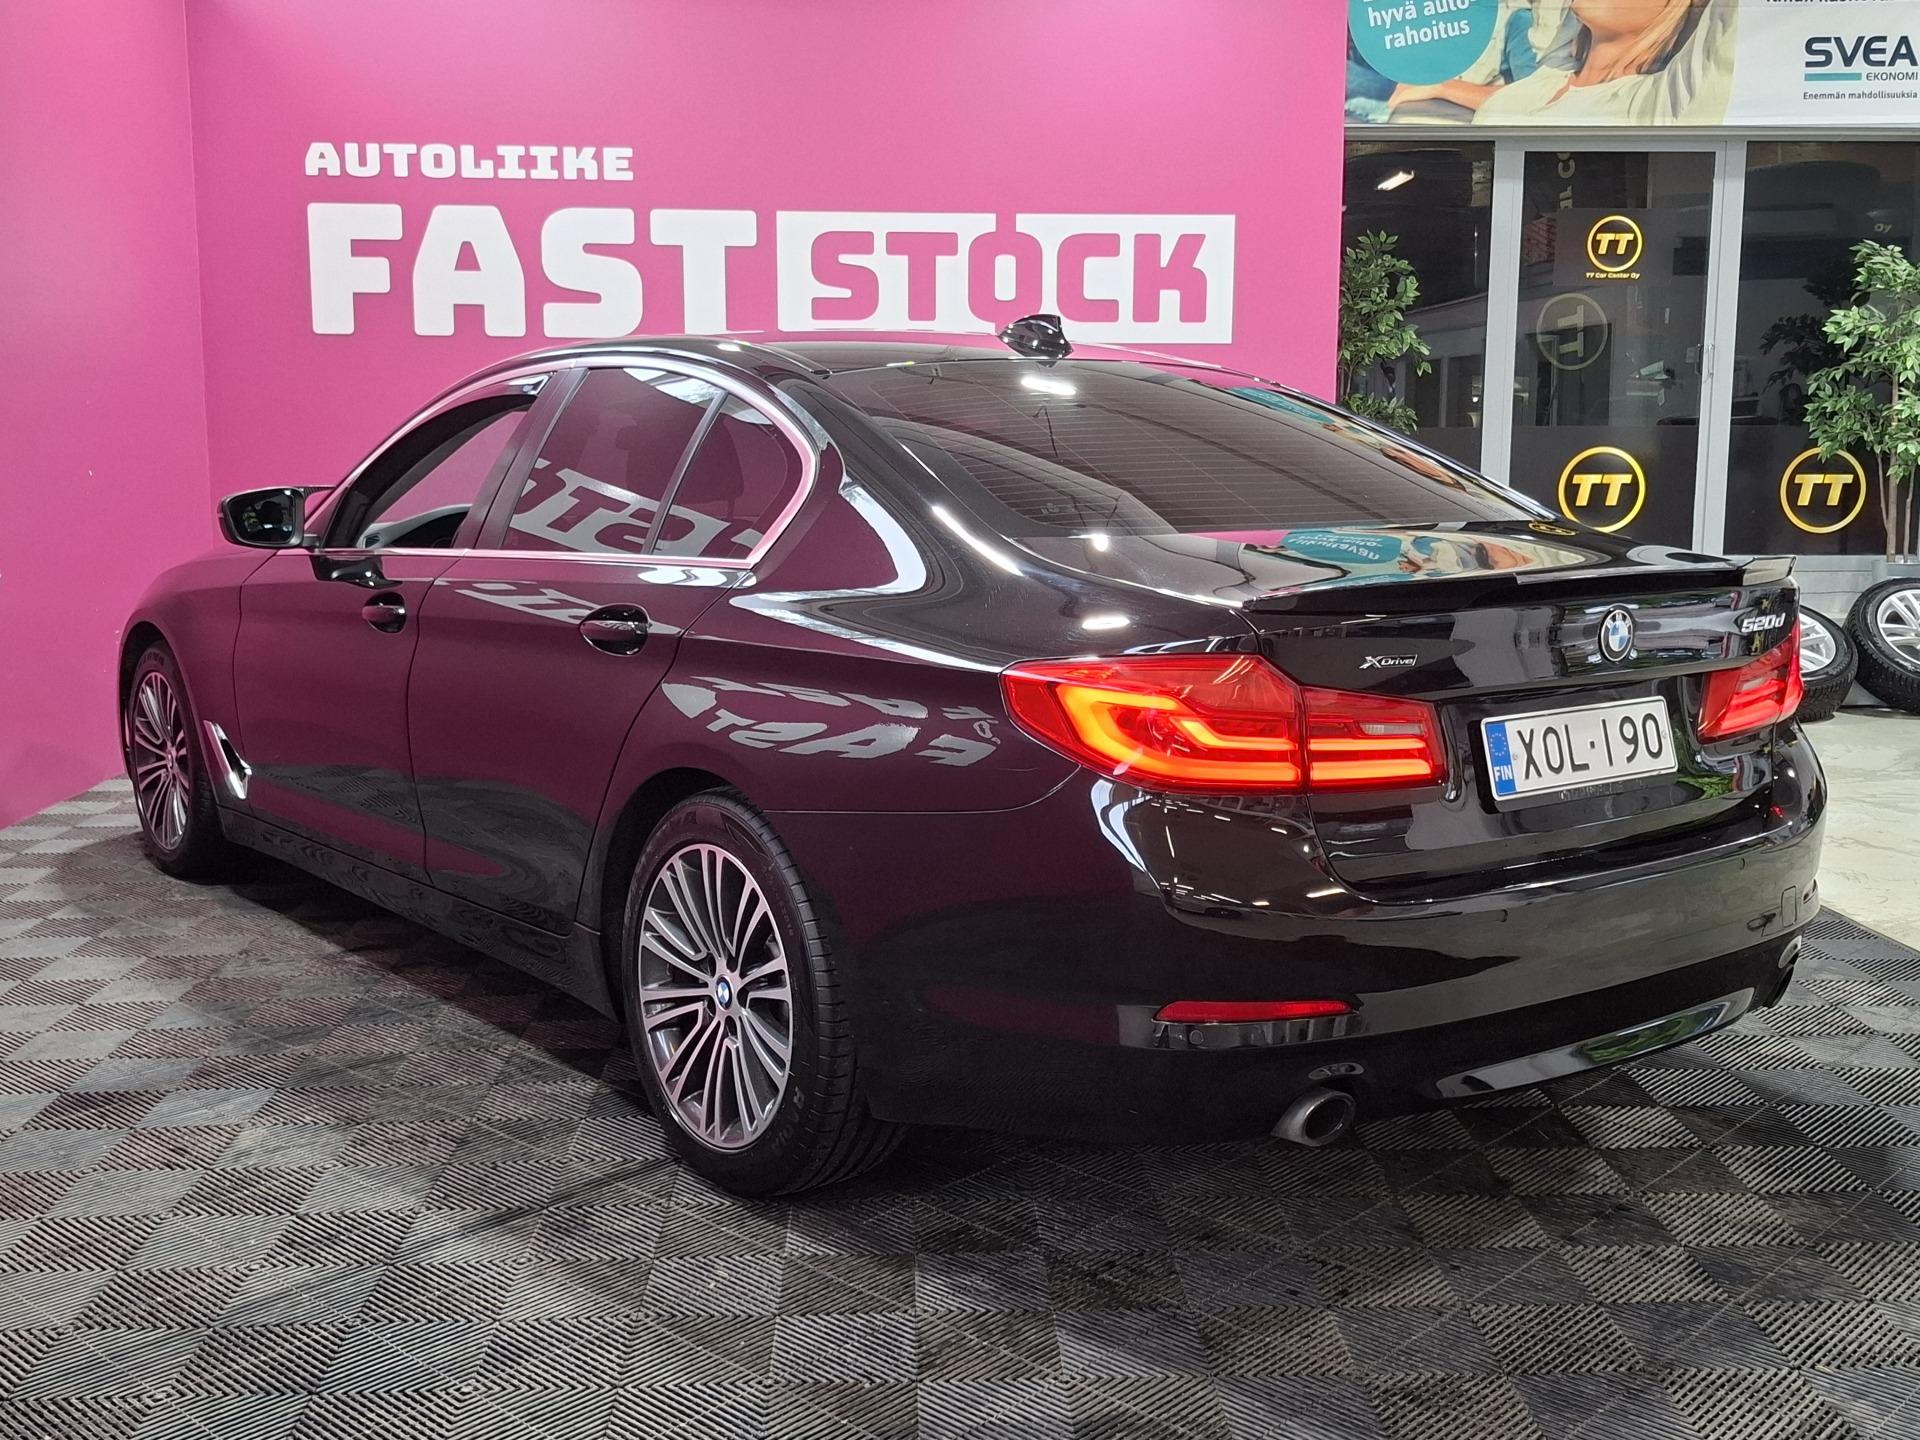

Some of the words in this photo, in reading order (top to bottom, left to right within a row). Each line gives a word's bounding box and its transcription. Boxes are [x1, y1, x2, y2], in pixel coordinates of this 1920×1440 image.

[1368, 1, 1417, 29] hyvä
[1385, 20, 1470, 49] rahoitus
[1805, 36, 1918, 67] SVEA
[1866, 72, 1918, 81] EKONOMI
[1803, 91, 1846, 100] Enemmän
[1848, 90, 1918, 99] mahdollisuuksia
[304, 142, 634, 181] AUTOLIIKE
[1596, 233, 1635, 254] TT
[307, 203, 757, 338] FAST
[811, 229, 1207, 324] STOCK
[1572, 474, 1633, 507] TT
[1794, 474, 1854, 506] TT
[1741, 612, 1786, 633] 520d
[1494, 764, 1513, 782] FIN
